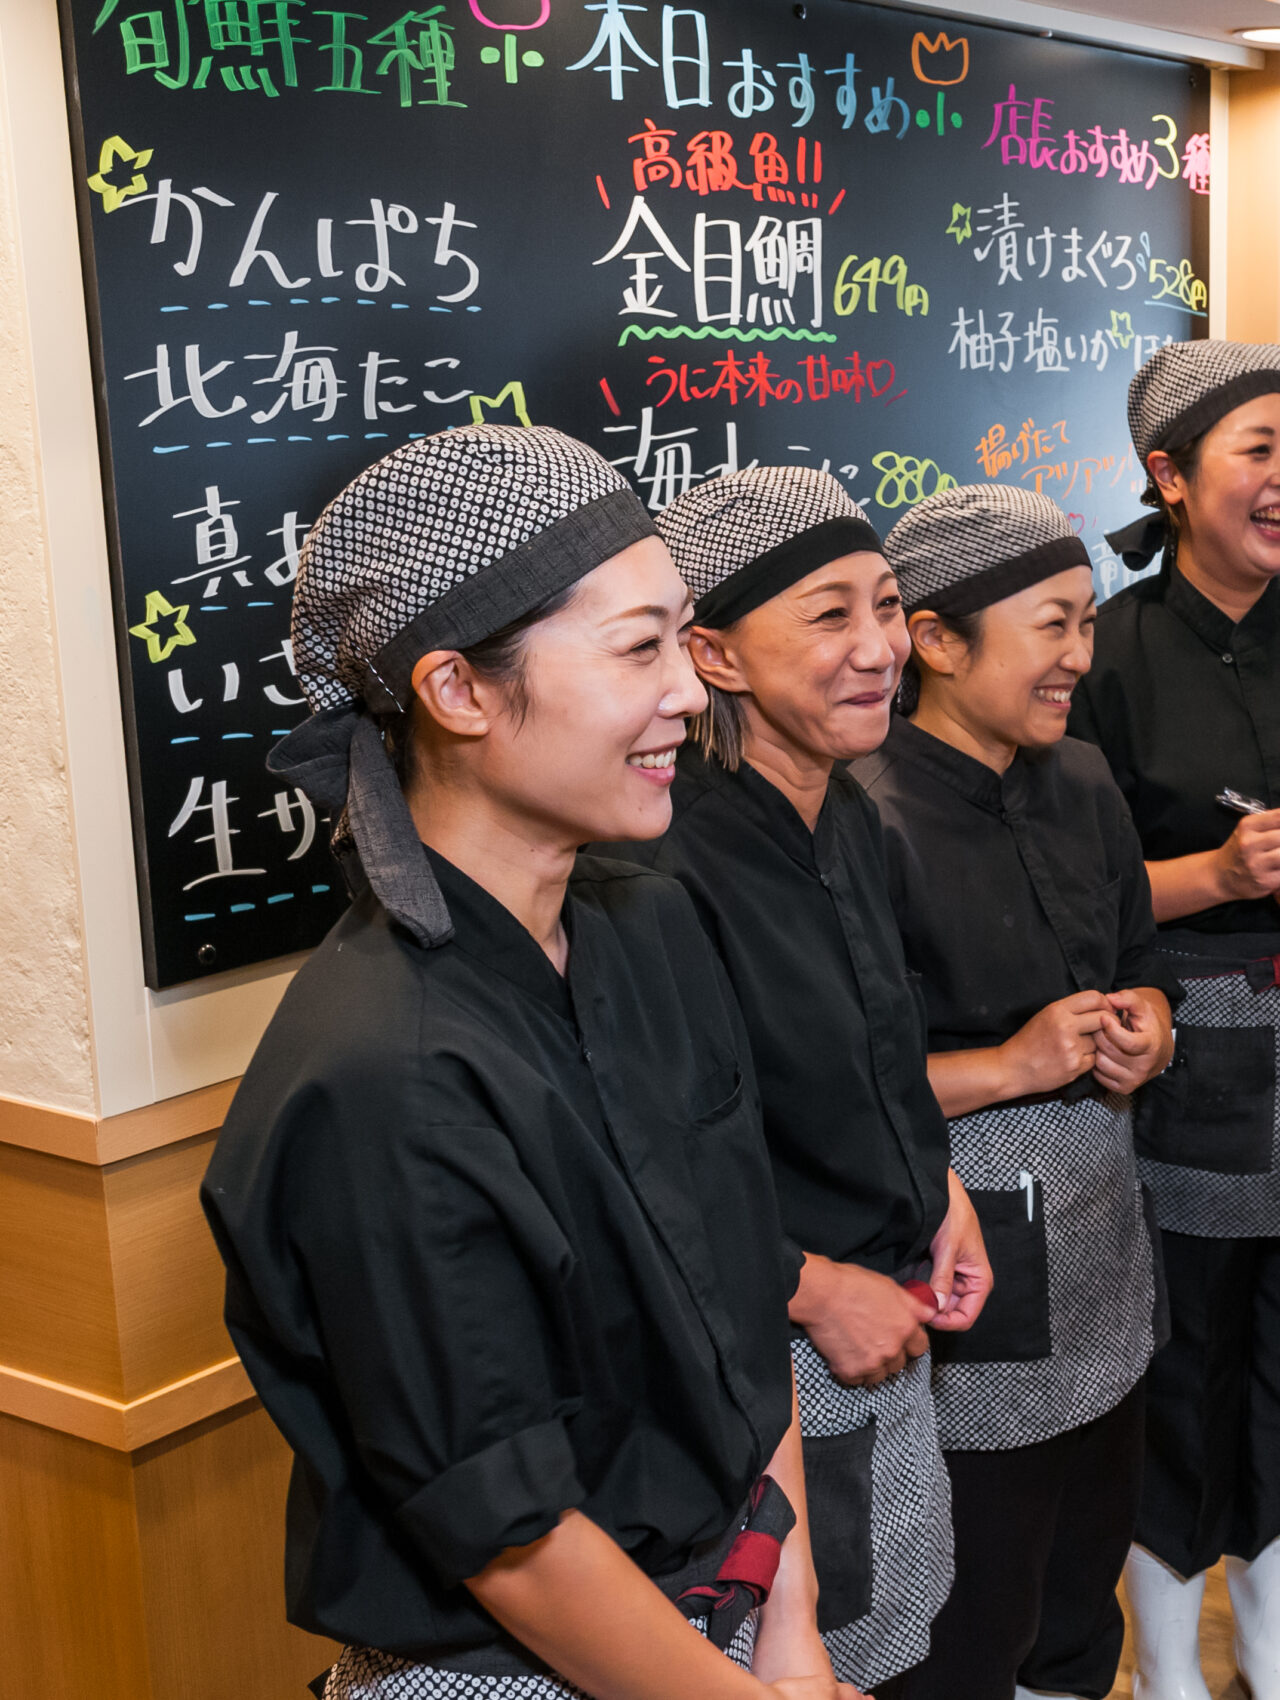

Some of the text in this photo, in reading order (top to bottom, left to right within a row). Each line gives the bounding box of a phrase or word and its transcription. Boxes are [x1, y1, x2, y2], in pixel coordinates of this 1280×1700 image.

[565, 0, 911, 140] 本日おすすめ
[118, 178, 480, 303] かんぱち
[592, 195, 929, 328] 金目鯛 649円
[973, 192, 1208, 311] 漬けまぐろ 528円
[123, 330, 475, 427] 北海たこ
[974, 417, 1071, 478] 揚げたて
